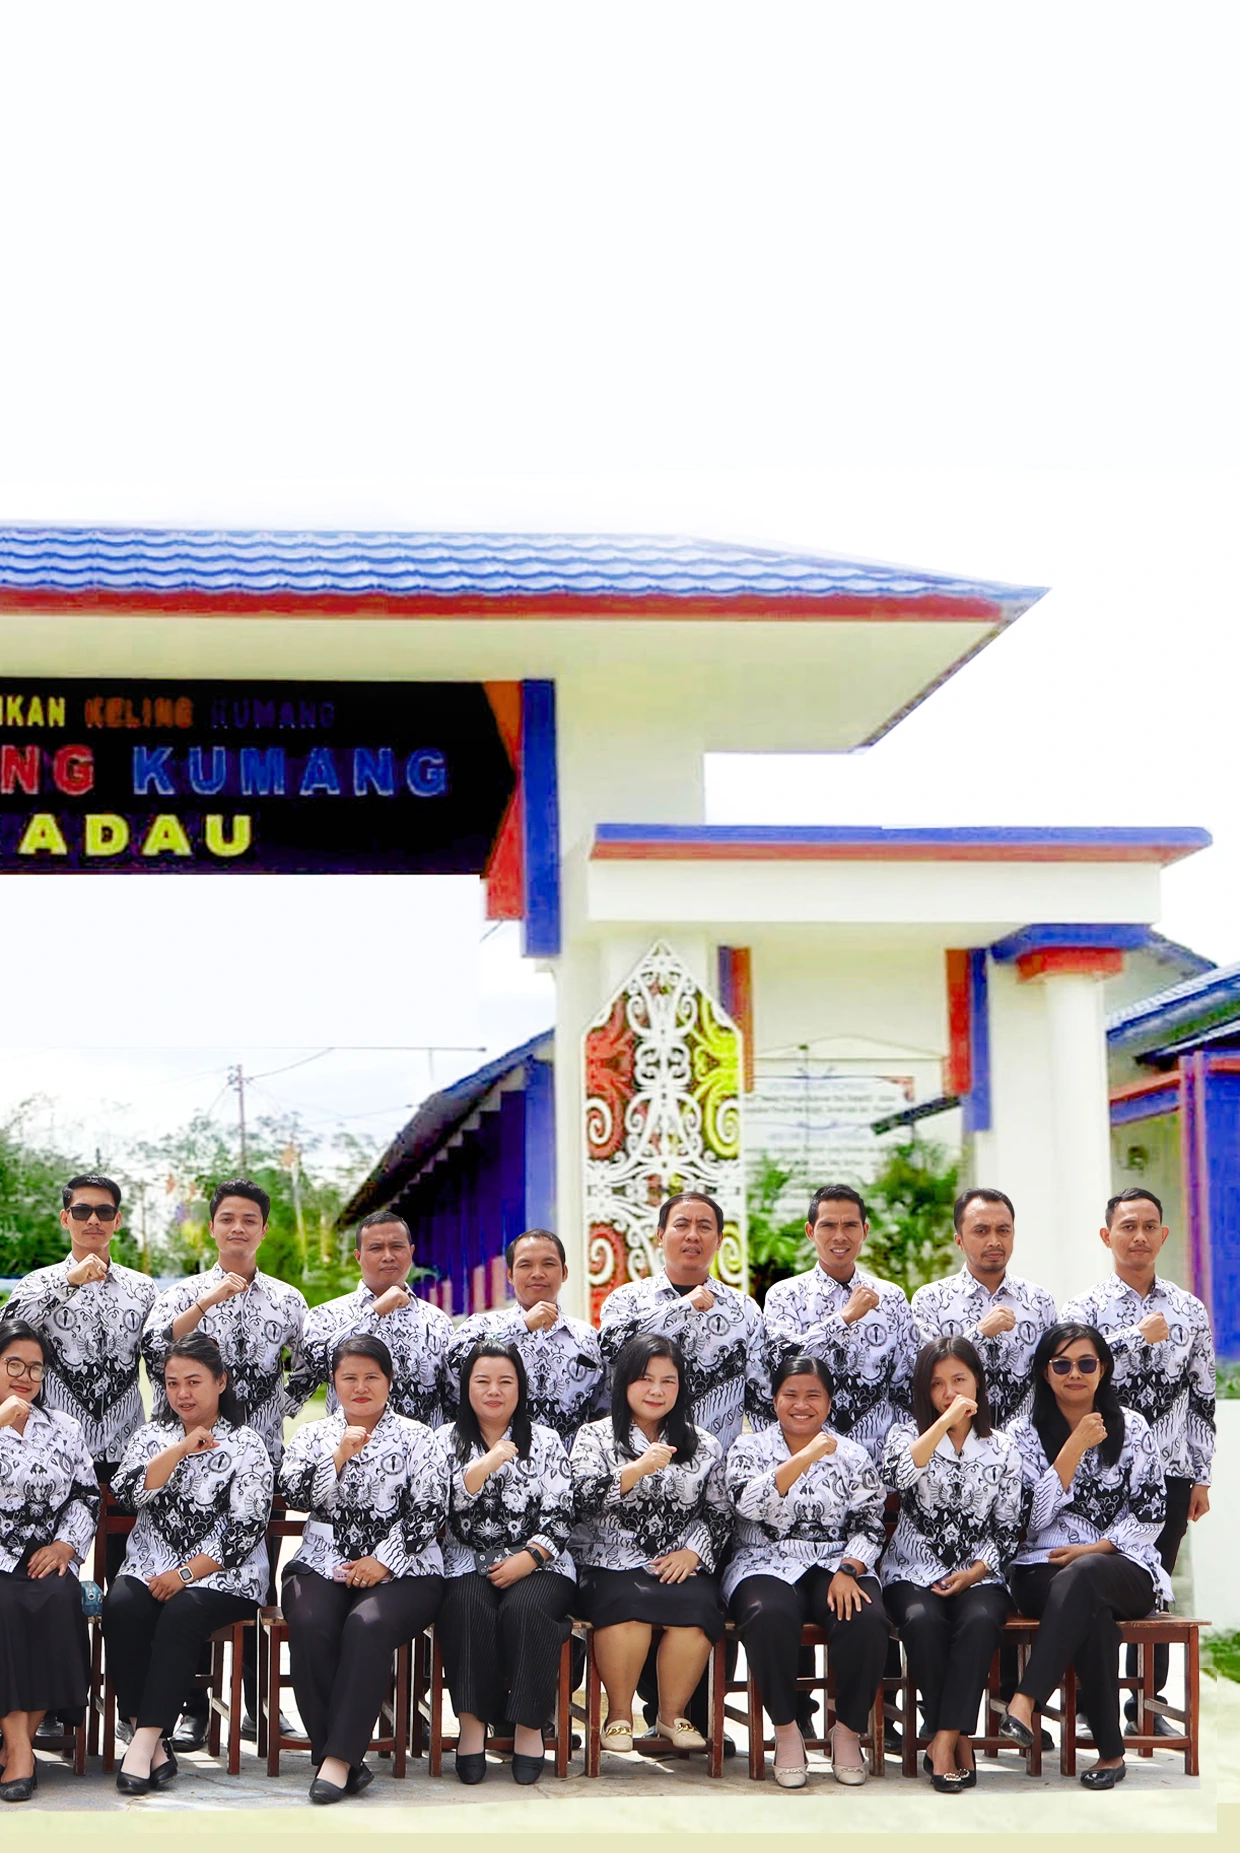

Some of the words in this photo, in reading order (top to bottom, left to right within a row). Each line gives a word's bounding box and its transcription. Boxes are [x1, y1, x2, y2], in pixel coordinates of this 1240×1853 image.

[85, 698, 192, 729] KELING
[212, 700, 336, 730] KUMANG
[133, 747, 447, 796] KUMANG
